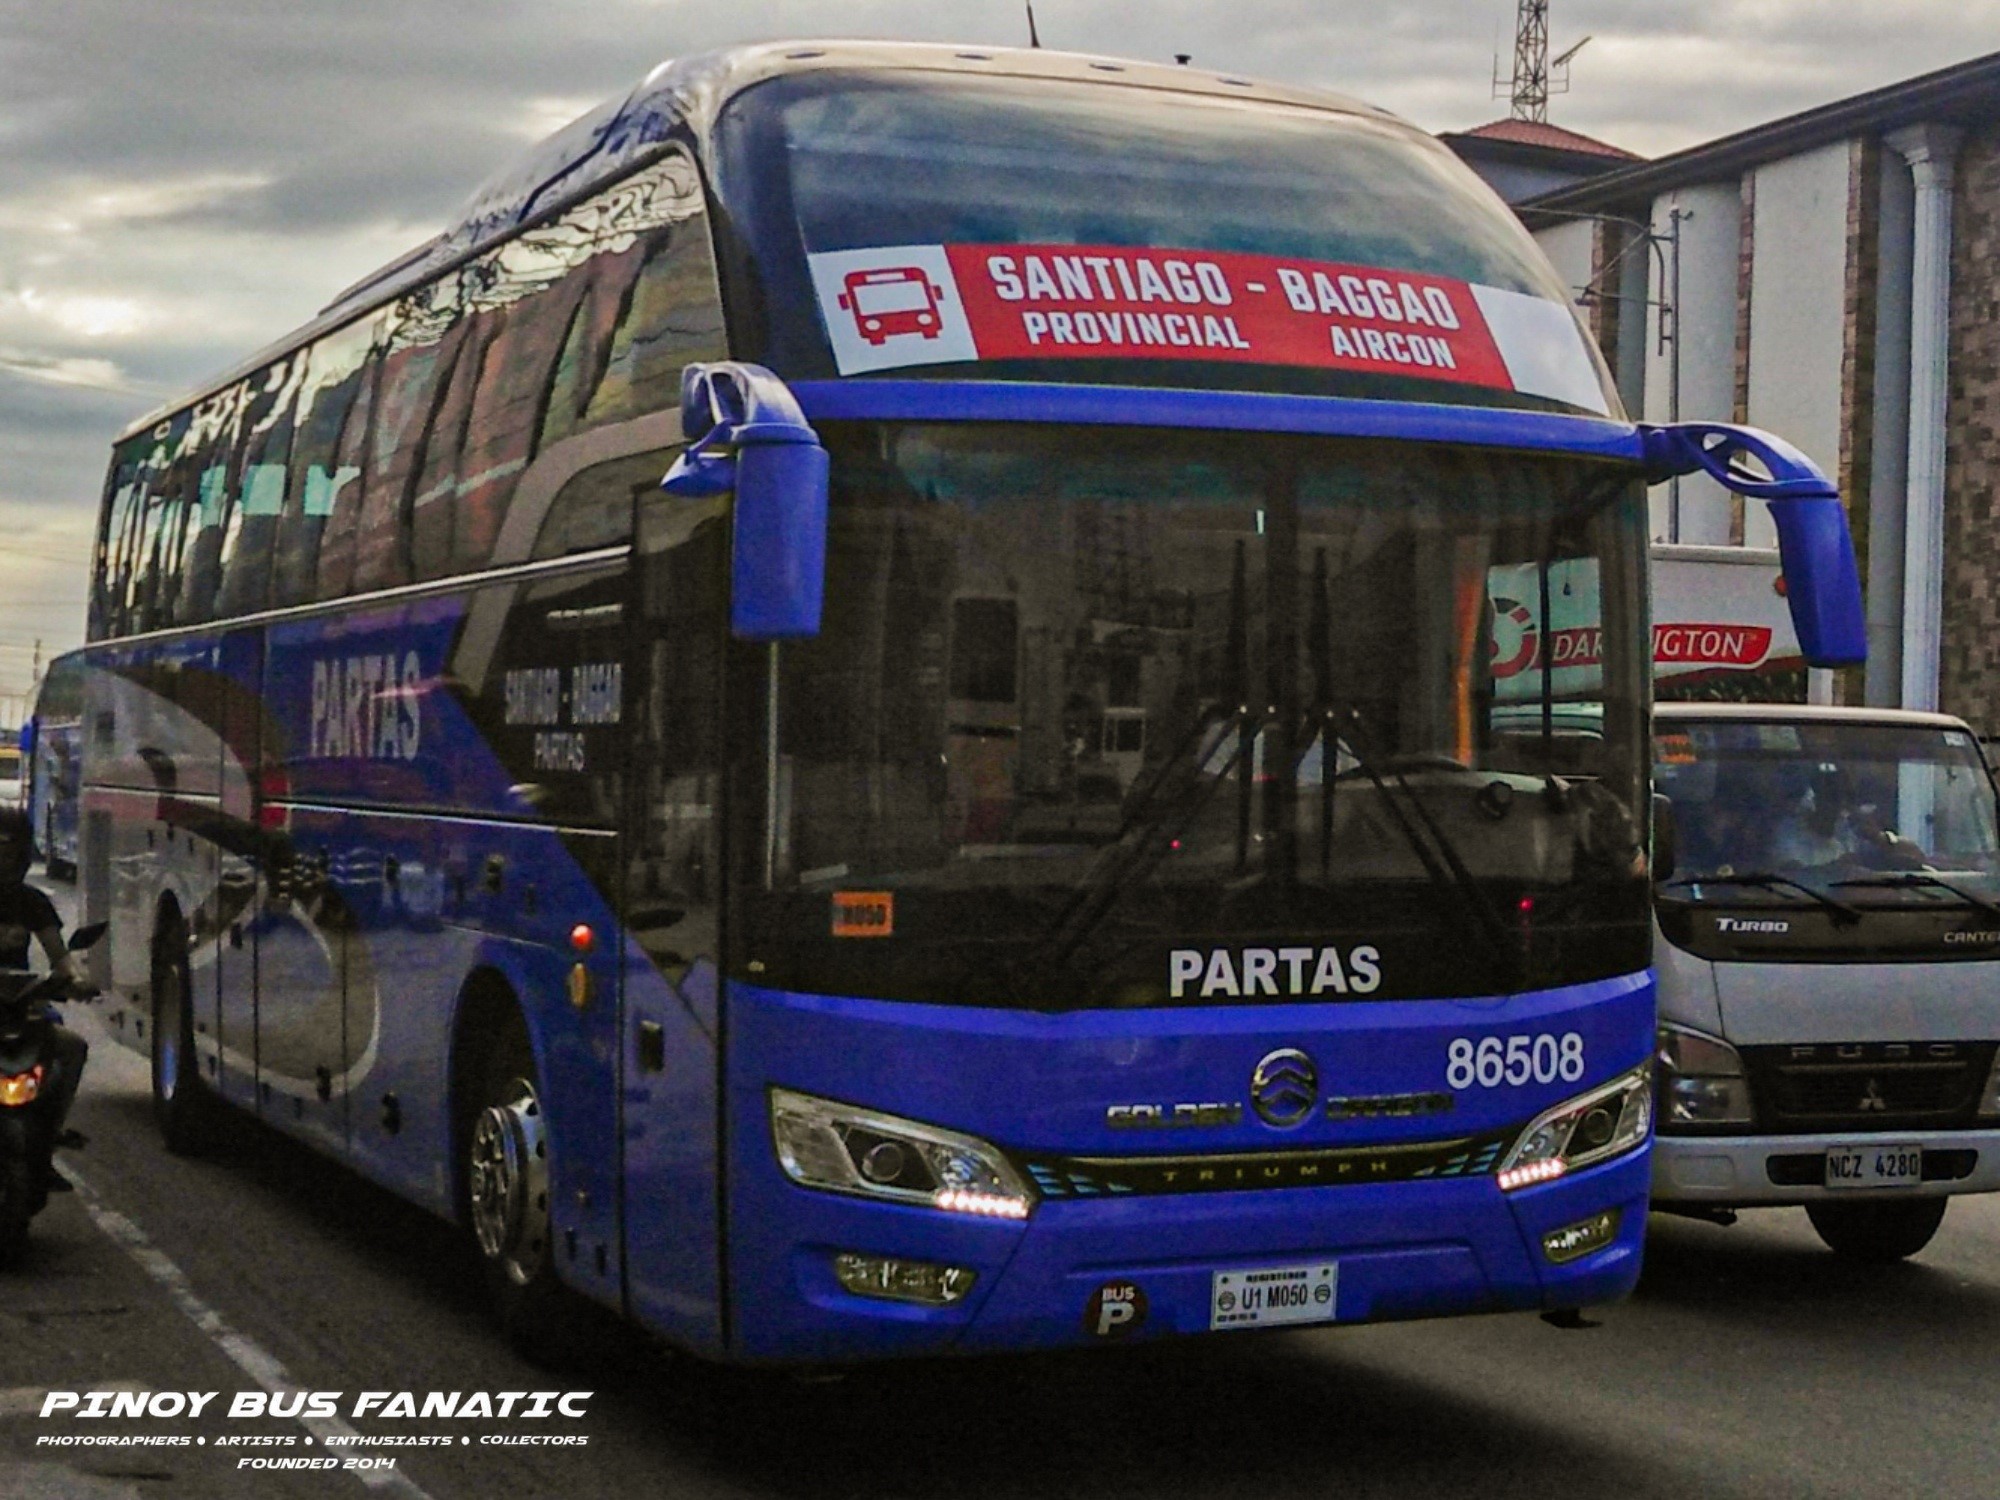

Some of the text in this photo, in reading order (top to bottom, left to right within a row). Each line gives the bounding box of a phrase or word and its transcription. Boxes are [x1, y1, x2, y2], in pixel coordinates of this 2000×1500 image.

[987, 255, 1233, 306] SANTIAGO
[1277, 268, 1460, 329] BAGGAO
[1022, 311, 1250, 349] PROVINCIAL
[1330, 325, 1457, 369] AIRCON
[311, 650, 421, 763] PARTAS
[1944, 931, 2000, 943] CANTE
[1170, 946, 1382, 998] PARTAS
[1446, 1033, 1585, 1089] 86508
[1163, 1161, 1387, 1182] TRIUMPH
[1829, 1154, 1918, 1178] NCZ 4280
[1102, 1286, 1135, 1301] BUS
[1242, 1283, 1308, 1310] U1 M050
[1097, 1302, 1135, 1335] P
